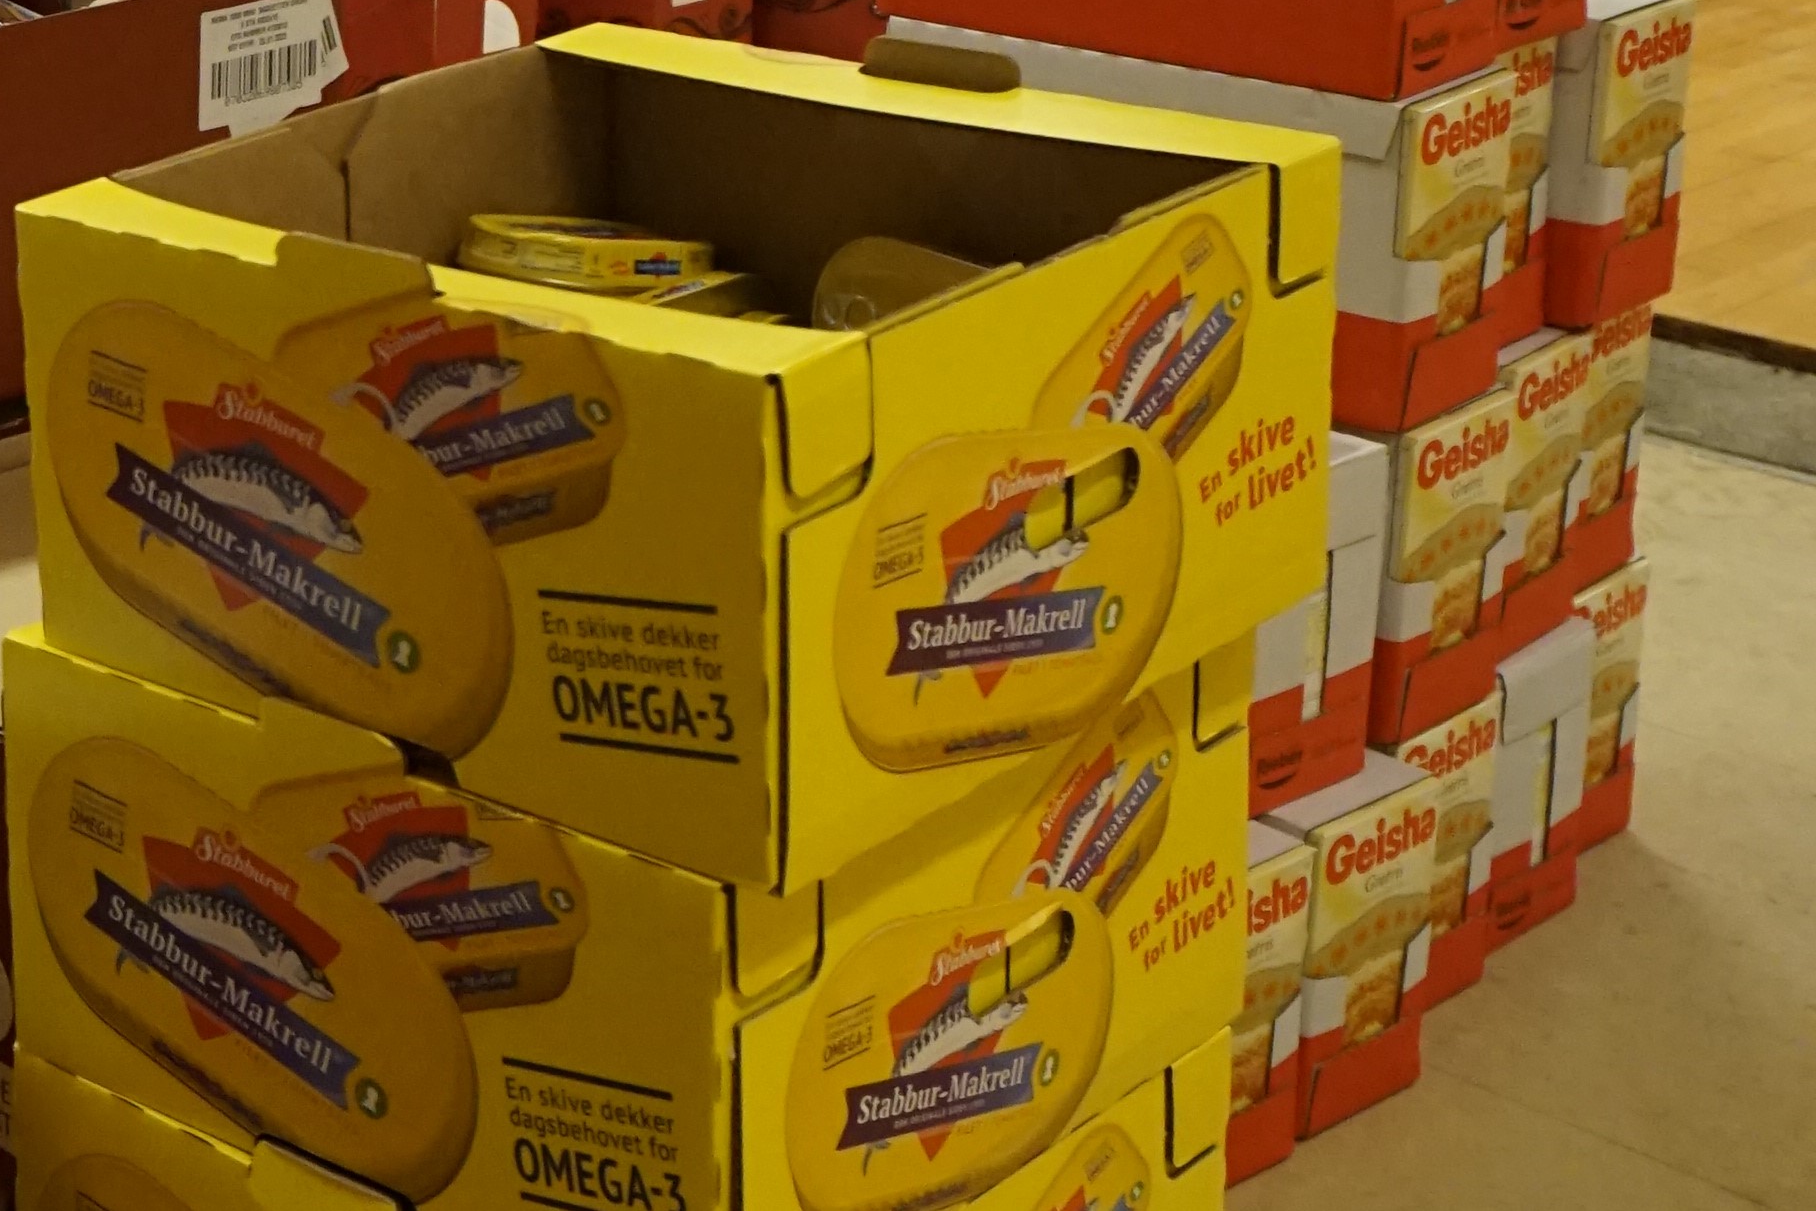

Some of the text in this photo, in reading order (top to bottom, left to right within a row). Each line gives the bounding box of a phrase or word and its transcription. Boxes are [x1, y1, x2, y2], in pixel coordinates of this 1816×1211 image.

[1512, 47, 1554, 98] isha
[1616, 15, 1692, 78] Geisha
[1421, 95, 1512, 166] Geisha
[1517, 351, 1592, 421] Geisha
[1199, 416, 1295, 503] En skive
[1215, 435, 1316, 526] for livet!
[1416, 414, 1510, 490] Geisha
[130, 467, 364, 631] Stabbur-Makrell
[542, 611, 720, 650] En skive dekker
[907, 599, 1086, 650] Stabbur-Makrell
[1577, 583, 1648, 639] eisha
[547, 642, 723, 680] dagsbehovet for
[553, 675, 733, 741] OMEGA-3
[1326, 807, 1436, 886] Geisha
[1128, 859, 1217, 952] En skive
[1143, 876, 1236, 973] for livet!
[1247, 876, 1308, 938] isha
[108, 895, 332, 1074] Stabbur-Makrell
[505, 1077, 675, 1134] En skive dekker
[856, 1056, 1025, 1125] Stabbur-Makrell
[510, 1106, 679, 1162] dagsbehovet for
[514, 1137, 687, 1211] OMEGA-3
